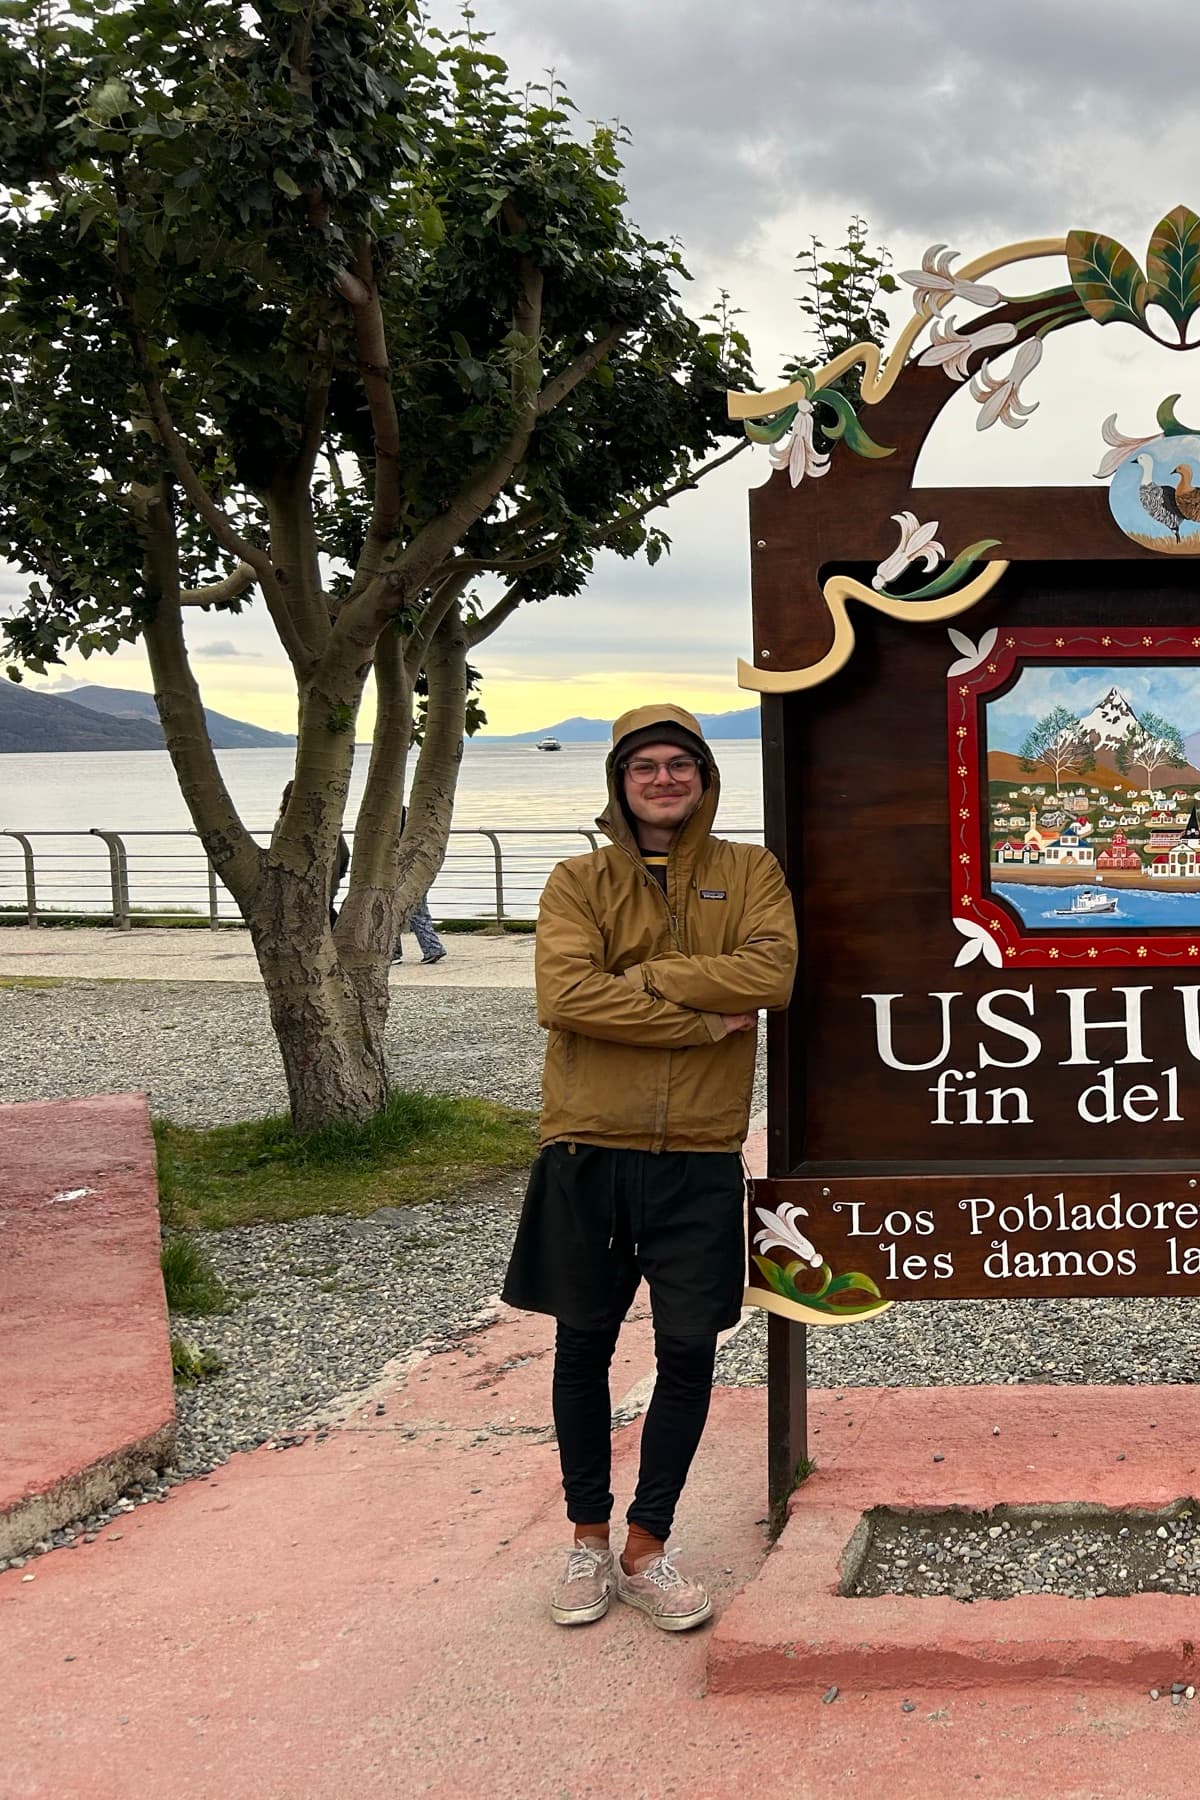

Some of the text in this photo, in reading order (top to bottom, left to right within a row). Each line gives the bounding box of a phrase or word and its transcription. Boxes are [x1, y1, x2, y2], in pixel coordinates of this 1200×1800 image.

[928, 1069, 1034, 1125] fin
[1077, 1066, 1185, 1124] del
[832, 1202, 935, 1237] Los
[878, 1242, 954, 1280] les
[983, 1239, 1137, 1279] damos
